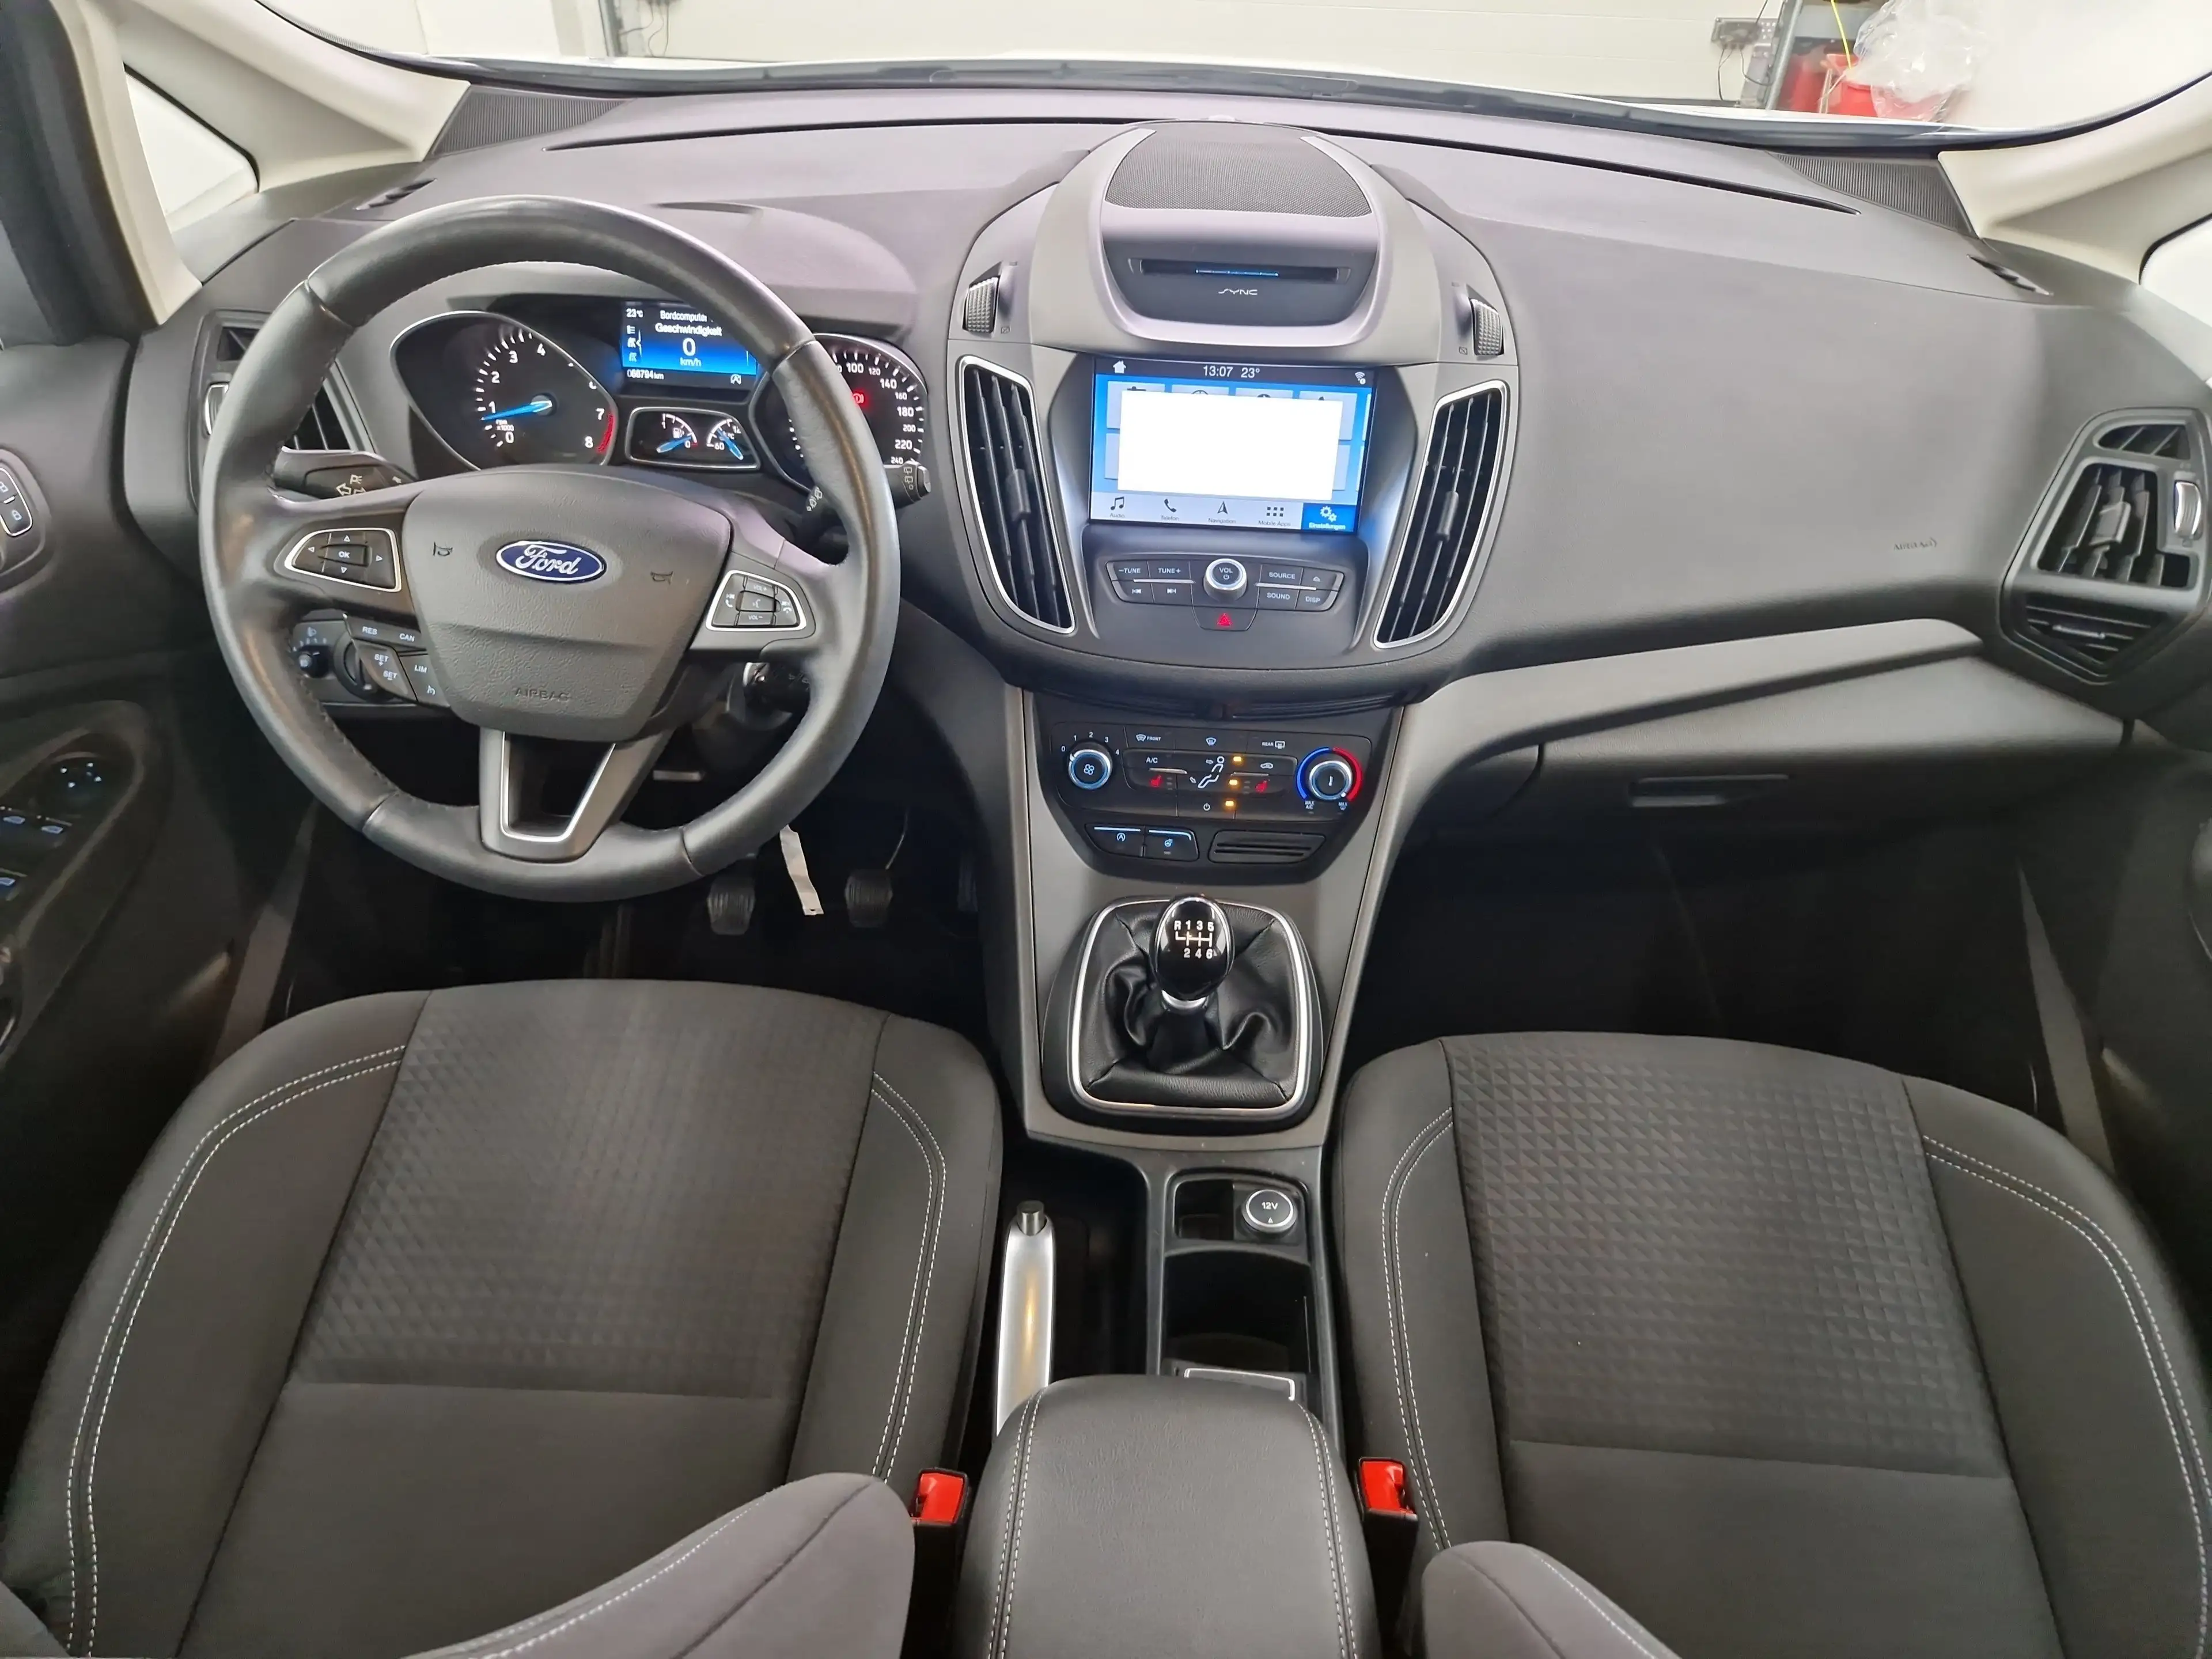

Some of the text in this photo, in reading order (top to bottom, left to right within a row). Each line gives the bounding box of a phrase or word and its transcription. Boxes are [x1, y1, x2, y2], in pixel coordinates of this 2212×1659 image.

[1218, 288, 1258, 296] SYNC
[655, 323, 722, 336] Geschwindigkeit
[537, 343, 546, 356] 4
[682, 338, 696, 357] 0
[509, 350, 518, 363] 3
[680, 357, 702, 367] km/h
[846, 362, 864, 373] 100
[869, 367, 881, 376] 120
[1203, 365, 1260, 378] 13:07 23°
[491, 371, 500, 384] 2
[880, 378, 897, 389] 140
[895, 392, 907, 400] 160
[488, 400, 496, 414] 1
[897, 406, 914, 417] 180
[596, 408, 605, 421] 7
[903, 424, 916, 432] 200
[505, 431, 514, 444] 0
[584, 435, 594, 448] 8
[714, 442, 725, 450] 60
[895, 439, 912, 450] 220
[891, 456, 904, 464] 240
[338, 551, 350, 559] OK
[515, 544, 582, 575] Ford
[1267, 592, 1290, 600] SOUND
[362, 626, 378, 635] RES
[399, 633, 415, 642] CAN
[374, 653, 389, 662] SET
[414, 664, 427, 673] LIM
[382, 670, 397, 679] SET
[1174, 919, 1214, 931] R 1 3 5
[1183, 948, 1213, 959] 2 4 6
[1262, 1202, 1278, 1210] 12V
